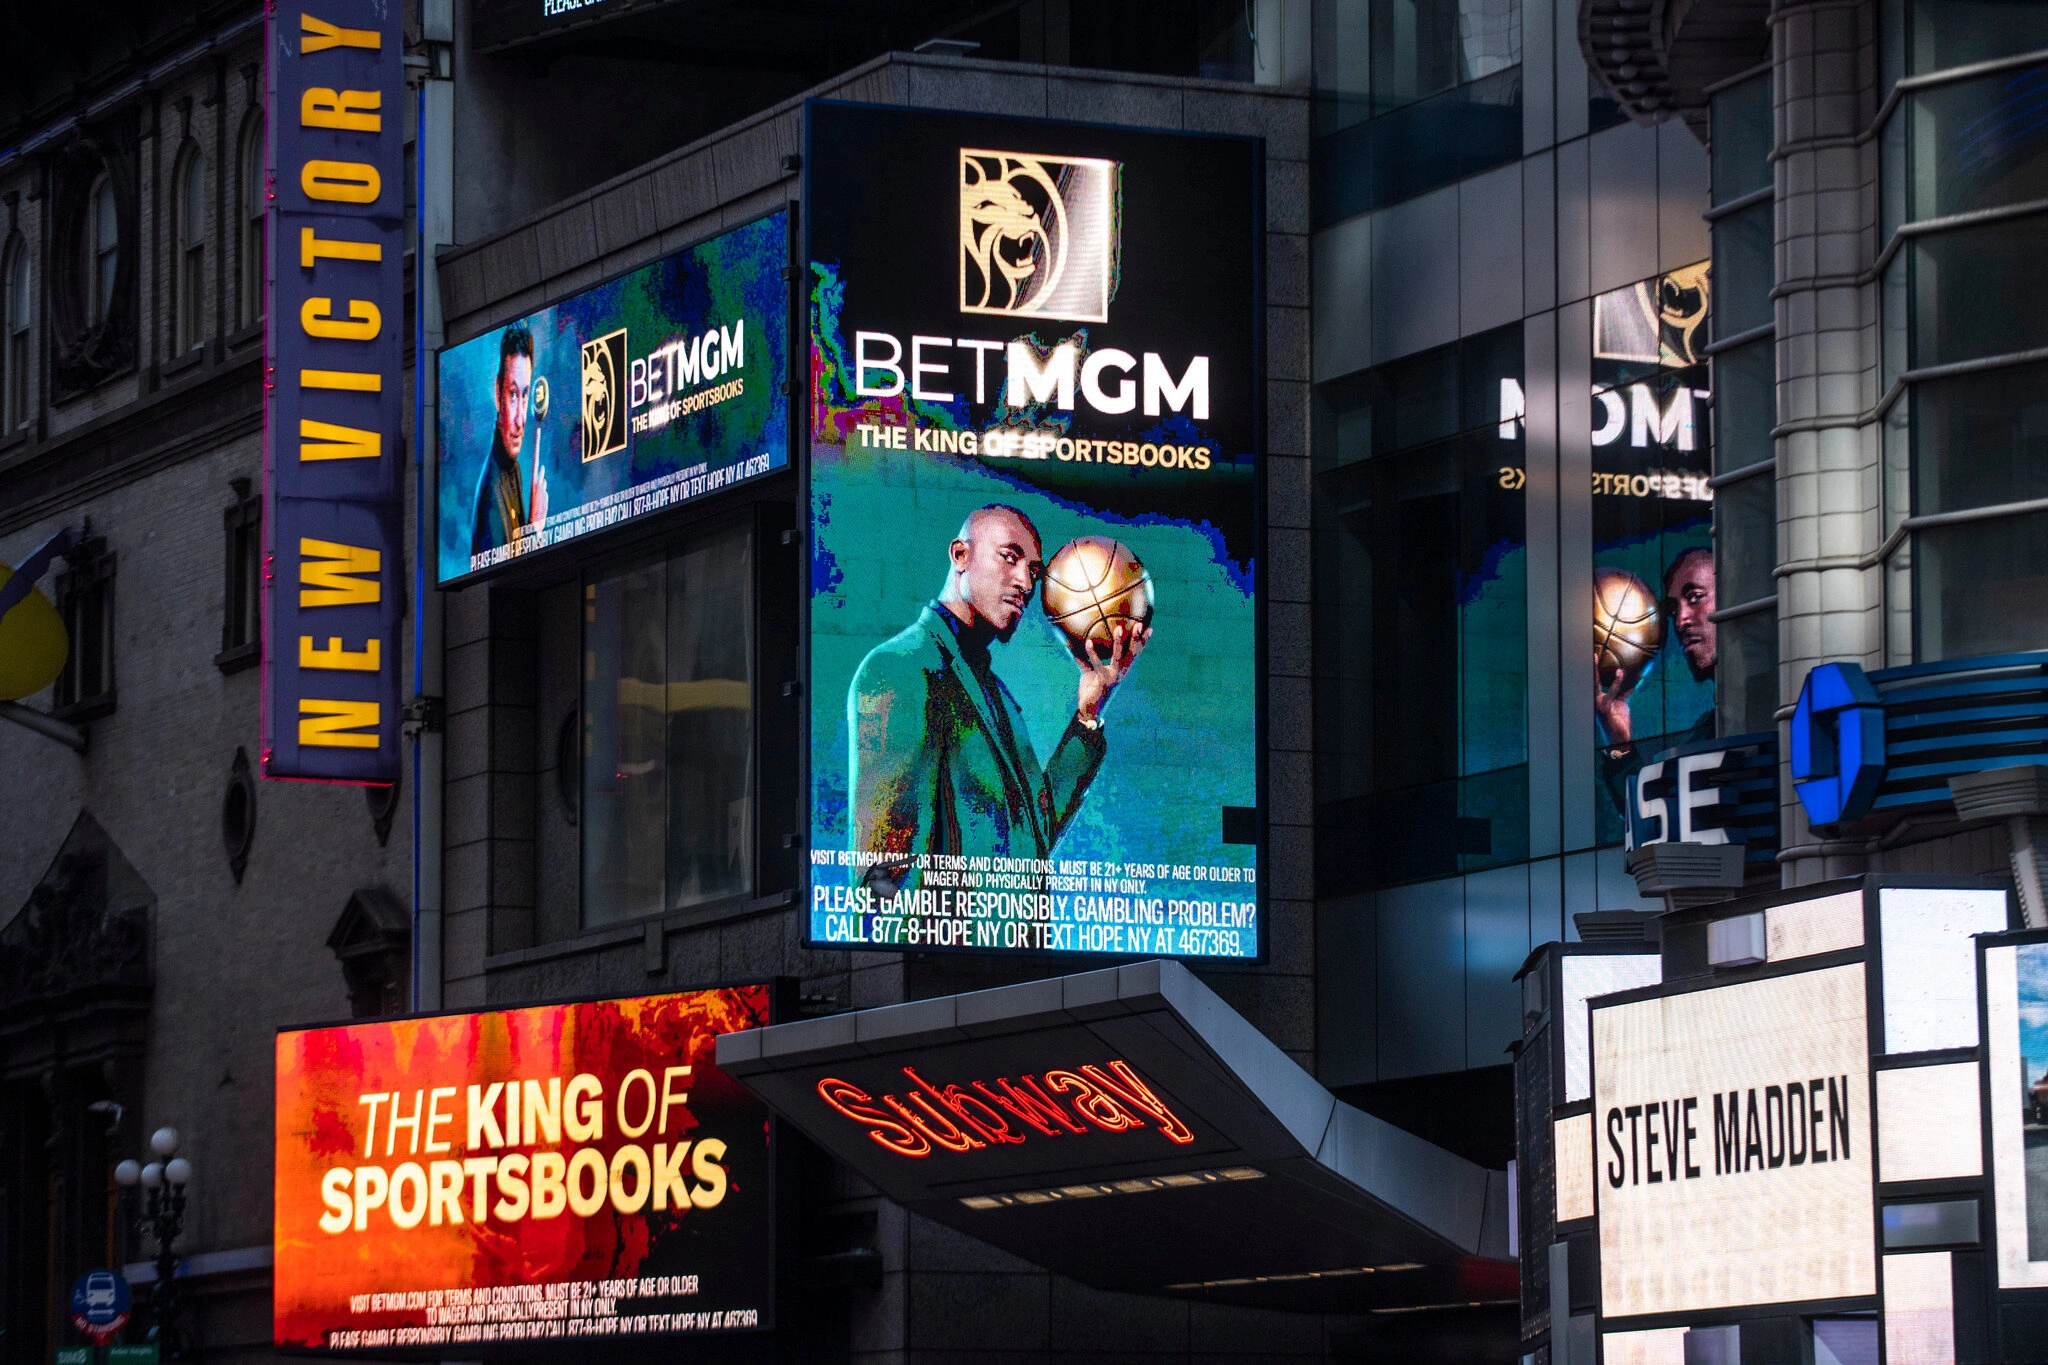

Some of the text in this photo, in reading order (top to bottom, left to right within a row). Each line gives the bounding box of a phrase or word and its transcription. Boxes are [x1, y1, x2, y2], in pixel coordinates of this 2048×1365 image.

[299, 12, 382, 748] NEW VICTORY
[631, 318, 744, 409] BETMGM
[854, 329, 1211, 419] BETMGM
[631, 413, 648, 434] THE
[669, 400, 682, 420] OF
[682, 378, 744, 416] SPORTSBOOKS
[857, 424, 1211, 470] THE KING OF SPORTSBOOKS
[810, 849, 836, 865] VISIT
[933, 854, 967, 871] TERMS
[969, 856, 991, 872] AND
[993, 857, 1057, 875] CONDITIONS.
[1059, 860, 1087, 876] MUST
[1090, 862, 1103, 877] BE
[1105, 862, 1122, 877] 21+
[1124, 862, 1155, 879] YEARS
[1157, 864, 1170, 879] OF
[1172, 865, 1191, 880] AGE
[1193, 866, 1207, 881] OR
[1209, 866, 1241, 882] OLDER
[1243, 868, 1256, 883] TO
[923, 870, 1147, 895] WAGER AND PHYSICALLY PRESENT IN NY ONLY.
[814, 885, 1257, 929] PLEASE GAMBLE RESPONSIBLY. GAMBLING PROBLEM?
[825, 914, 1244, 957] CALL 877-8-HOPE NY OR TEXT HOPE NY AT 467369.
[359, 1065, 692, 1158] THE KING OF
[816, 1059, 1194, 1158] Subway
[1607, 1075, 1850, 1188] STEVE MADDEN
[319, 1137, 728, 1234] SPORTSBOOKS
[350, 1294, 371, 1314] VISIT
[427, 1290, 444, 1308] FOR
[444, 1288, 473, 1306] TERMS
[473, 1287, 492, 1304] AND
[545, 1282, 570, 1301] MUST
[570, 1281, 582, 1299] BE
[598, 1279, 626, 1299] YEARS
[626, 1278, 638, 1298] OF
[639, 1277, 656, 1297] AGE
[657, 1276, 669, 1297] OR
[670, 1275, 699, 1295] OLDER
[426, 1307, 438, 1326] TO
[438, 1306, 467, 1325] WAGER
[467, 1304, 486, 1323] AND
[570, 1299, 580, 1318] IN
[580, 1298, 594, 1317] NY
[620, 1316, 633, 1334] NY
[696, 1312, 711, 1330] NY
[711, 1311, 724, 1329] AT
